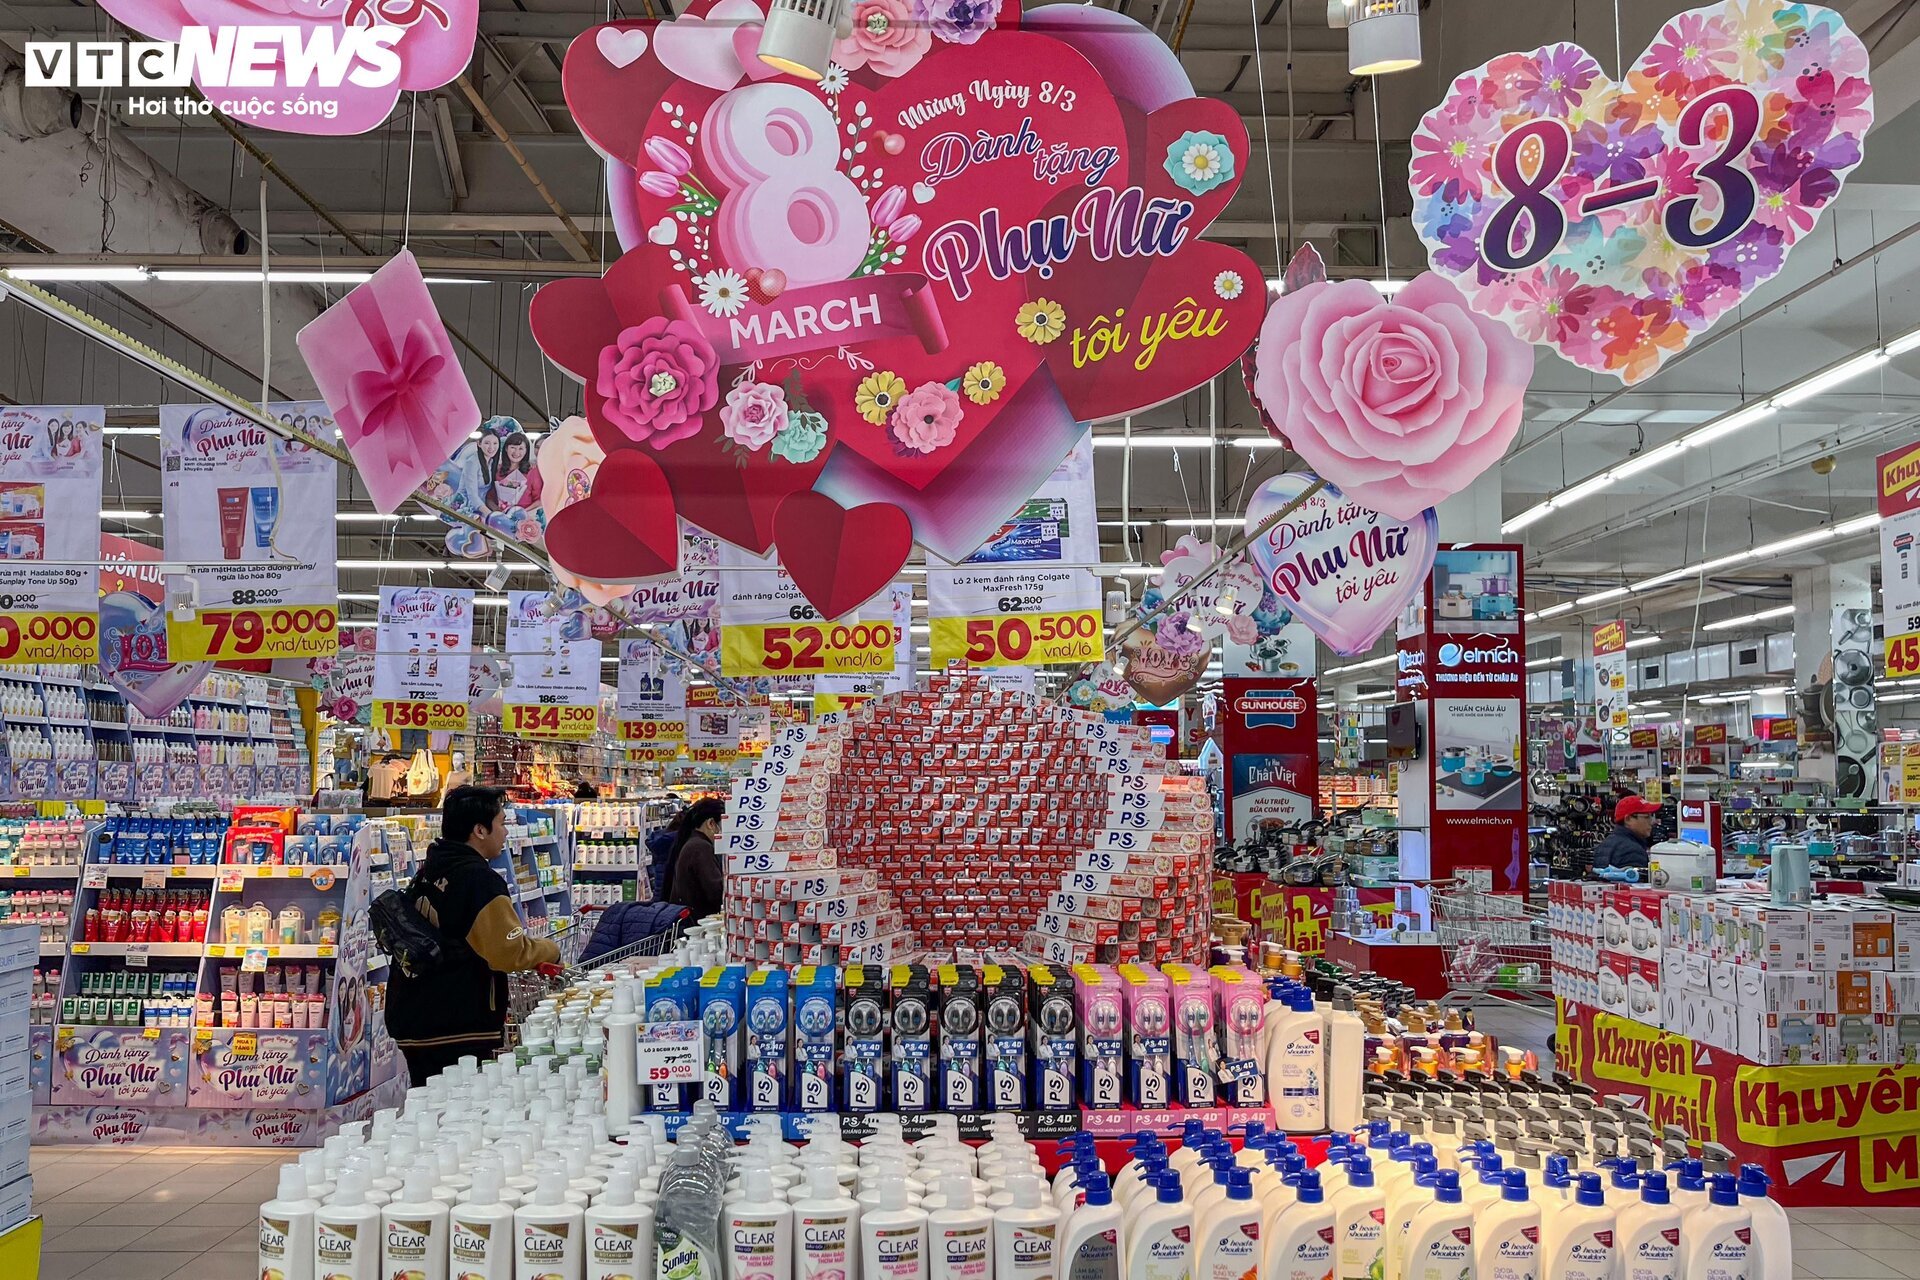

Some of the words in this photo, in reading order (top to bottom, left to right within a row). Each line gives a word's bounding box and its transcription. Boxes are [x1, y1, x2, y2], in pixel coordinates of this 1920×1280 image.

[898, 90, 968, 131] Mừng
[968, 79, 1032, 109] Ngày
[1037, 80, 1077, 112] 8/3
[919, 116, 1042, 187] Dành
[1031, 142, 1120, 186] tặng
[700, 81, 872, 290] 8
[921, 207, 1074, 302] Phụ
[1073, 185, 1195, 261] Nữ
[729, 293, 882, 349] MARCH
[1070, 308, 1130, 370] tôi
[1140, 297, 1228, 359] yêu
[200, 417, 233, 434] Dành
[2, 432, 34, 450] Nữ
[197, 433, 236, 456] Phụ
[237, 429, 267, 447] Nữ
[1310, 497, 1326, 508] 8/3
[1269, 509, 1335, 555] Dành
[1010, 537, 1042, 546] MaxFresh
[1271, 546, 1348, 603] Phụ
[1350, 526, 1409, 568] Nữ
[30, 569, 64, 577] Hadalabo
[65, 569, 82, 577] 80g
[267, 571, 282, 580] 80g
[953, 576, 963, 585] Lô
[973, 576, 992, 584] kem
[1037, 573, 1071, 582] Colgate
[48, 578, 58, 586] Up
[58, 577, 78, 586] 50g)
[982, 584, 1023, 592] MaxFresh
[1025, 583, 1044, 592] 175g
[1335, 576, 1360, 604] tôi
[1363, 568, 1400, 602] yêu
[633, 587, 680, 608] Phụ
[682, 580, 720, 599] Nữ
[667, 604, 680, 615] tôi
[682, 603, 702, 616] yêu
[998, 596, 1043, 612] 62.800
[202, 609, 336, 656] 79.000
[965, 614, 1097, 662] 50.500
[1044, 641, 1092, 658] vnd/lô
[25, 643, 94, 661] vnd/hộp
[266, 635, 336, 653] vnd/tuýp
[762, 625, 891, 670] 52.000
[835, 652, 883, 668] vnd/lô
[1464, 647, 1518, 663] elmich
[1241, 701, 1300, 710] SUNHOUSE
[1448, 704, 1473, 712] CHUẨN
[383, 702, 465, 727] 136.900
[512, 706, 594, 730] 134.500
[623, 721, 684, 739] 139.000
[630, 749, 675, 761] 170.900
[693, 749, 737, 761] 194.900
[1446, 816, 1513, 825] www.elmich.vn
[85, 1049, 121, 1064] Dành
[124, 1048, 150, 1061] tặng
[262, 1050, 288, 1063] tặng
[1597, 1031, 1686, 1078] Khuyến
[81, 1067, 122, 1088] Phụ
[125, 1063, 159, 1083] Nữ
[219, 1069, 260, 1091] Phụ
[264, 1065, 298, 1085] Nữ
[649, 1065, 690, 1080] 59.000
[119, 1085, 130, 1095] tôi
[132, 1084, 150, 1097] yêu
[257, 1087, 269, 1097] tôi
[96, 1113, 119, 1123] Dành
[256, 1113, 279, 1123] Dành
[1655, 1078, 1712, 1143] Mãi!
[960, 1115, 975, 1123] 4D
[93, 1124, 119, 1140] Phụ
[121, 1122, 142, 1134] Nữ
[253, 1124, 279, 1140] Phụ
[281, 1122, 302, 1134] Nữ
[260, 1229, 284, 1247] CLEAR
[388, 1232, 426, 1248] CLEAR
[453, 1234, 485, 1250] CLEAR
[734, 1230, 775, 1245] CLEAR
[805, 1228, 845, 1242] CLEAR
[318, 1236, 351, 1251] CLEAR
[524, 1237, 563, 1251] CLEAR
[595, 1237, 633, 1251] CLEAR
[878, 1238, 919, 1254] CLEAR
[946, 1239, 986, 1254] CLEAR
[1013, 1240, 1052, 1252] CLEAR
[662, 1250, 698, 1274] Sunlight
[1152, 1250, 1184, 1258] shoulders
